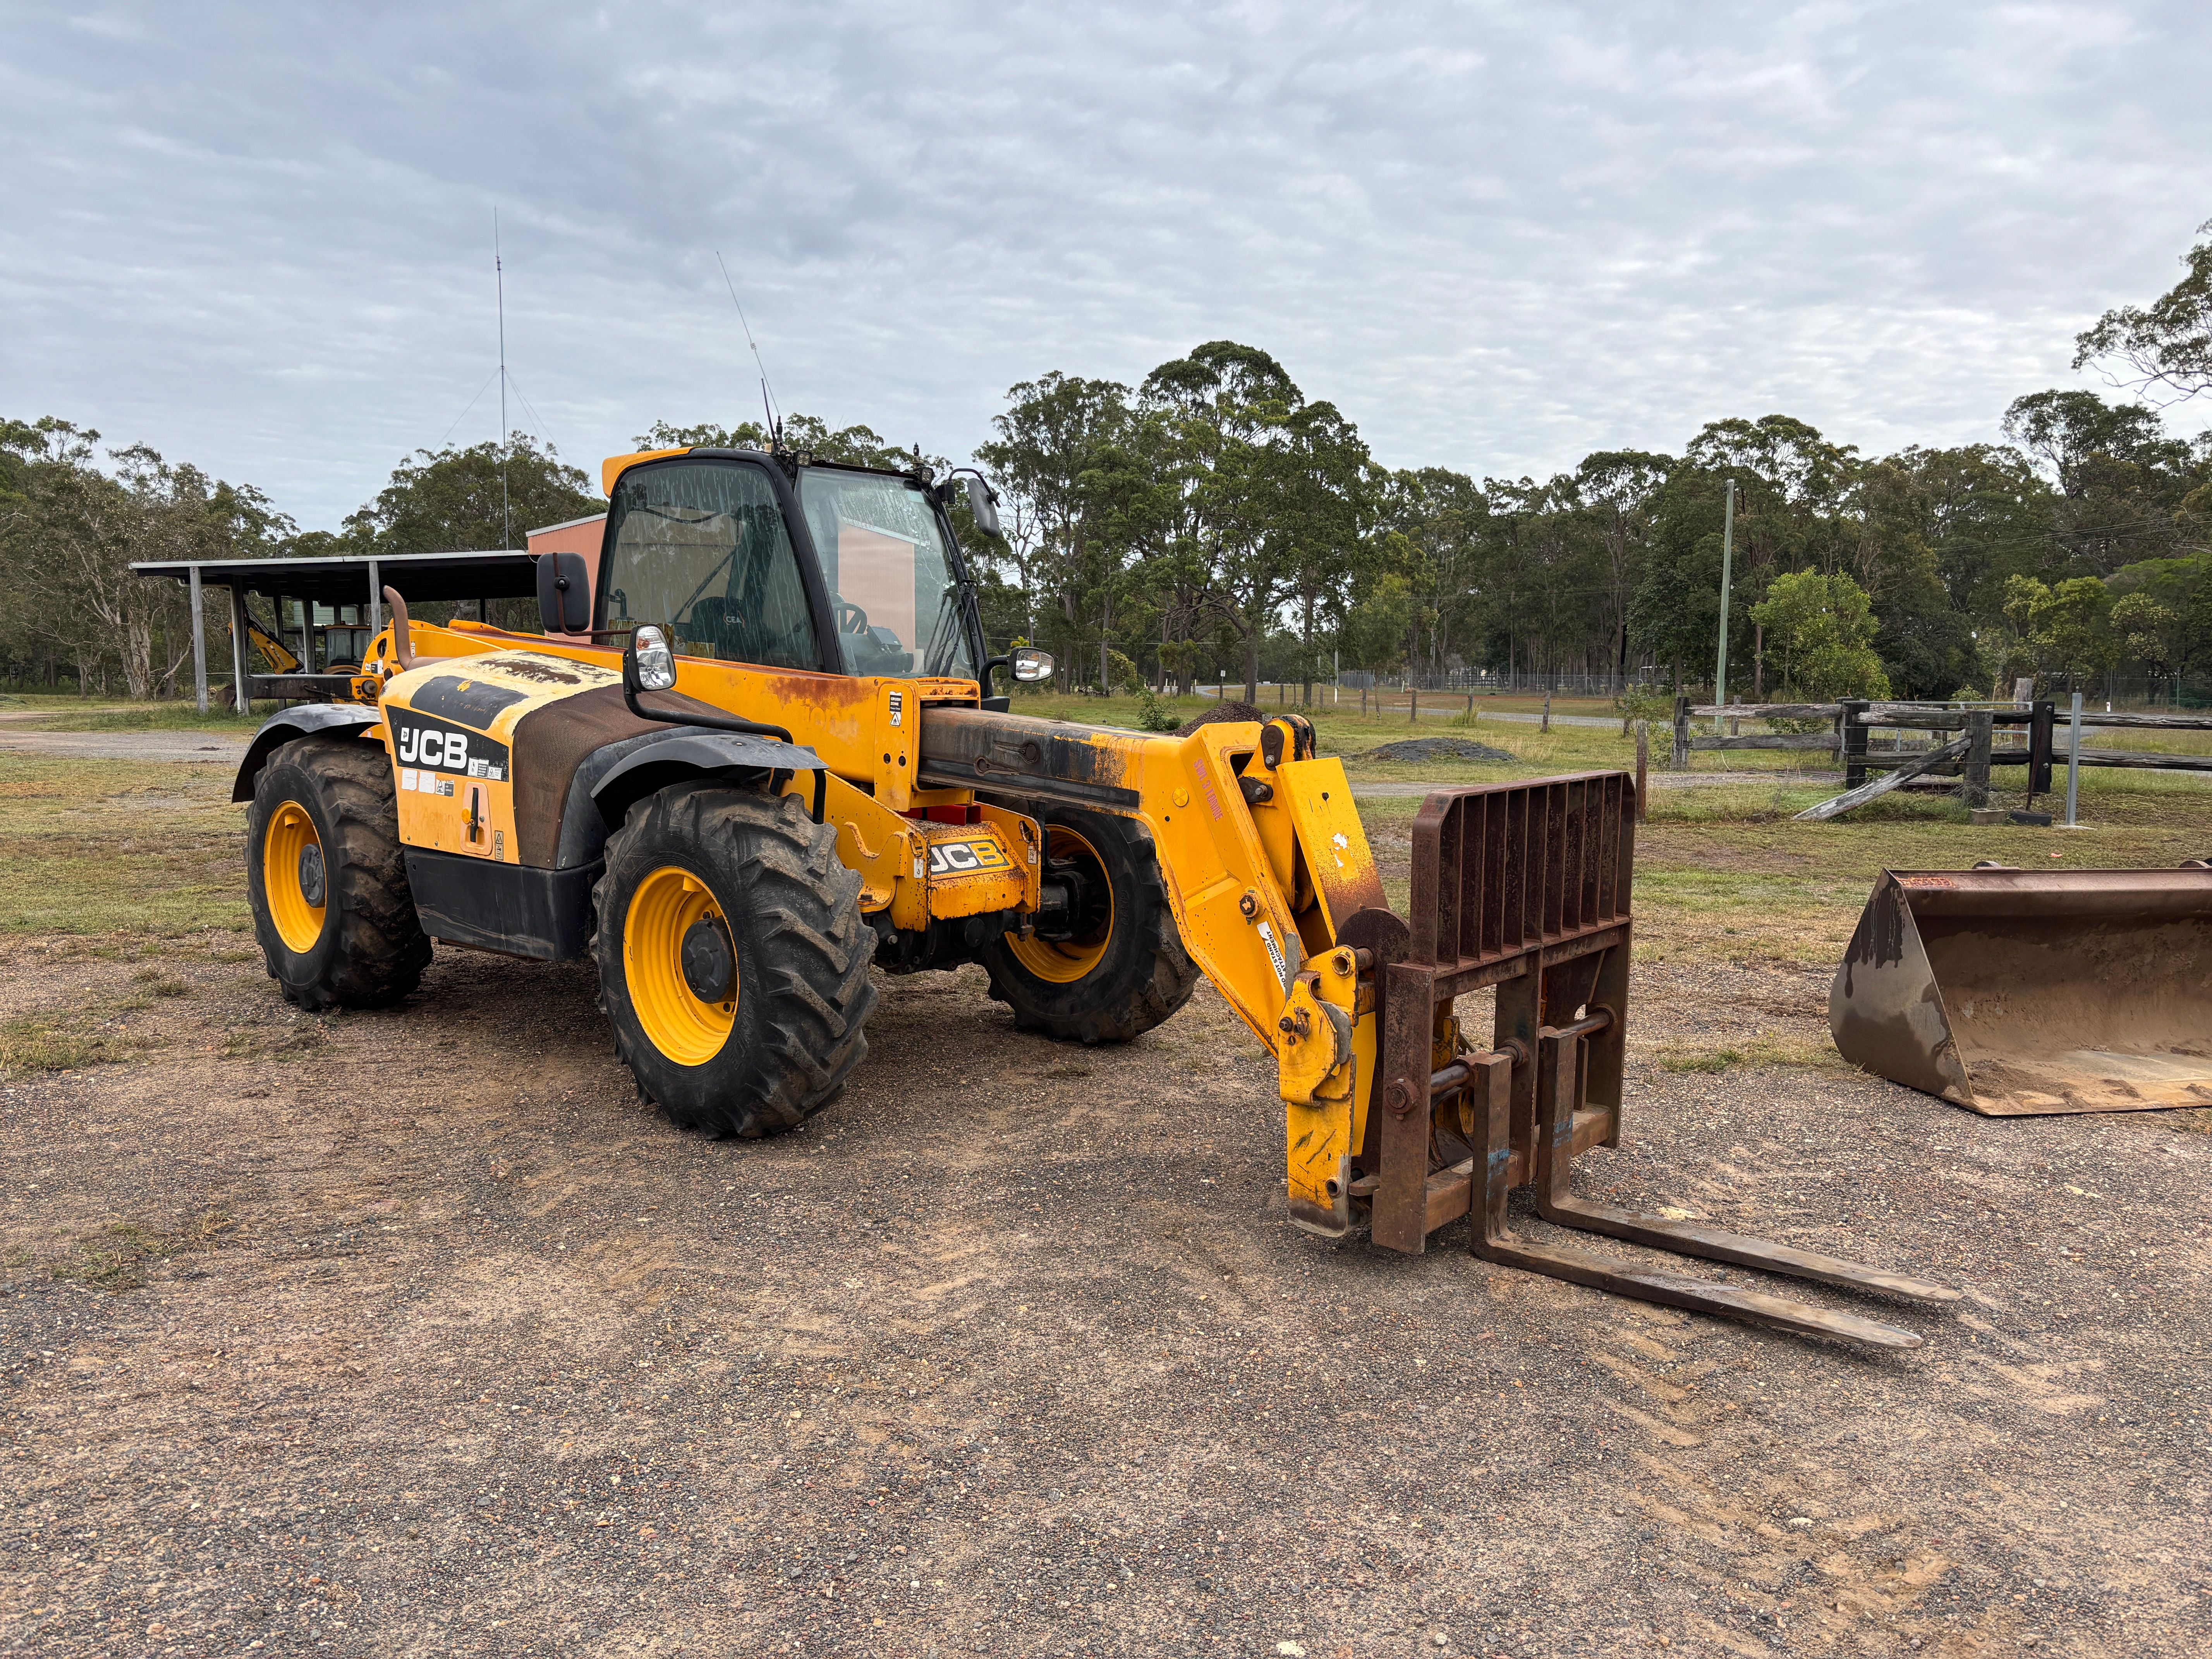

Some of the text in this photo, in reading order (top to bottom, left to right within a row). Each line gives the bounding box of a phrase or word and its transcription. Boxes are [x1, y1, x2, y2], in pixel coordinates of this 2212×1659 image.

[400, 727, 468, 769] JCB
[931, 842, 1005, 872] JCB
[1266, 931, 1286, 972] ATTACHMENT
[1267, 943, 1278, 963] STAND
[1275, 964, 1283, 977] NOT
